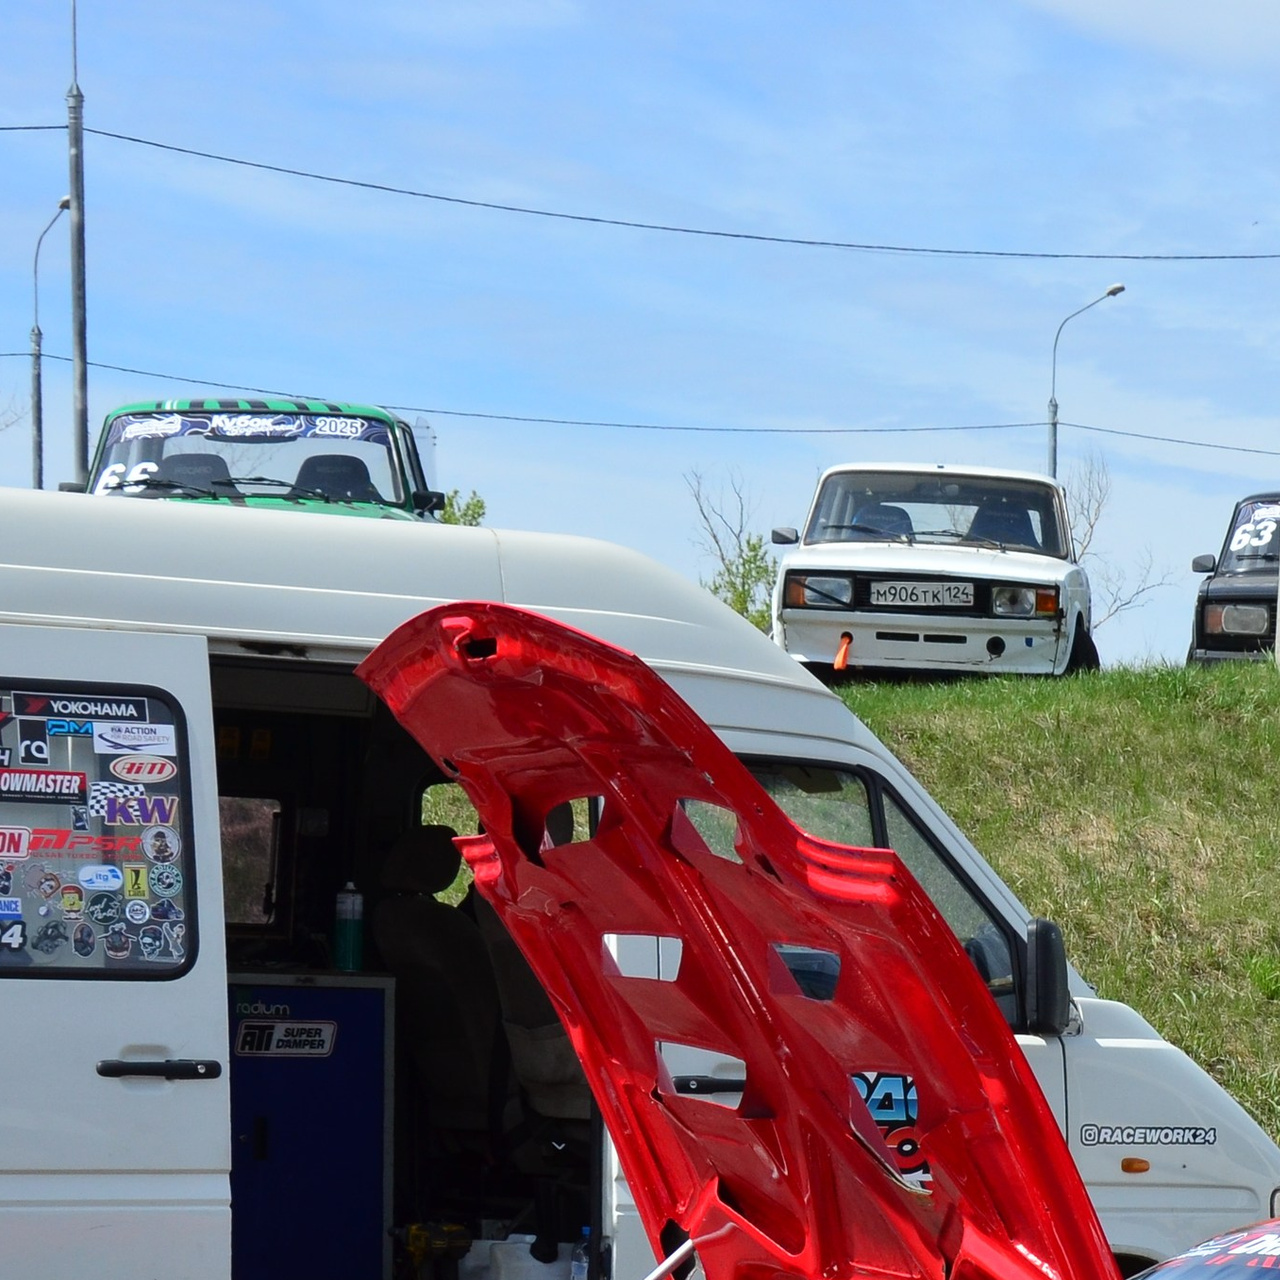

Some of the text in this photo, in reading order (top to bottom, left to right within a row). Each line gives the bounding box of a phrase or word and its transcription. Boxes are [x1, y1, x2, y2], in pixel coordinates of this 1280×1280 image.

[318, 418, 361, 435] 2025
[1230, 520, 1277, 552] 63
[944, 586, 970, 599] 124
[50, 700, 138, 718] YOKOHAMA
[124, 727, 157, 735] ACTION
[105, 796, 178, 825] KW
[240, 1025, 275, 1052] ATI
[284, 1028, 322, 1038] SUPER
[276, 1039, 325, 1050] DAMPER
[1100, 1127, 1216, 1144] RACEWORK24
